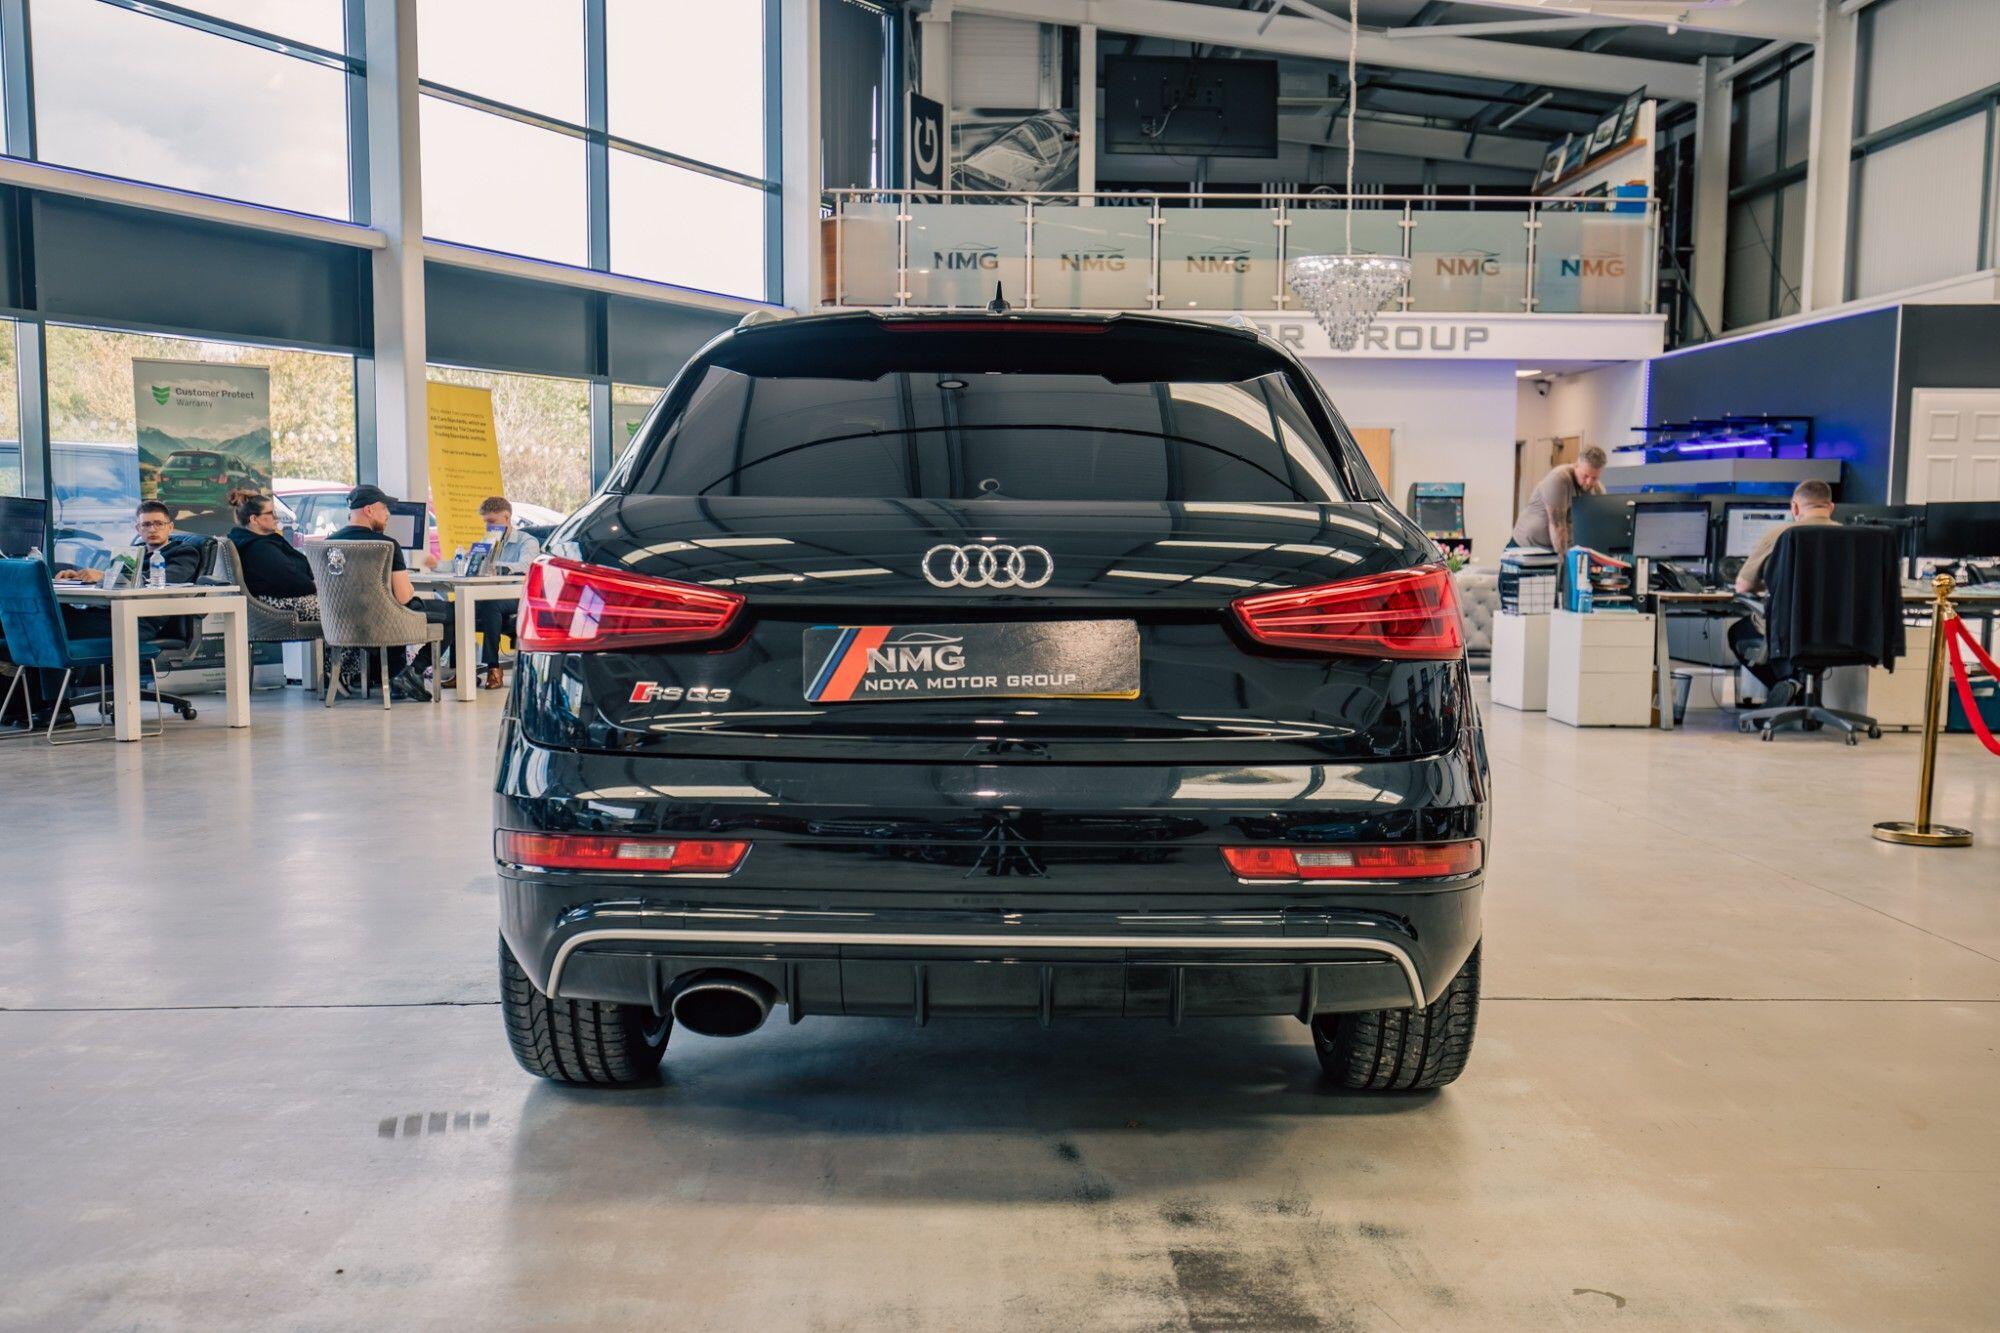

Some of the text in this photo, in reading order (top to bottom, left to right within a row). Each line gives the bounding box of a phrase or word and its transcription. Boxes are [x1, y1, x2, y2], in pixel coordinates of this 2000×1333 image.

[933, 251, 999, 270] NMG
[1060, 253, 1125, 272] NMG
[1186, 255, 1250, 273] NMG
[1436, 258, 1500, 276] NMG
[1561, 259, 1625, 276] NMG
[175, 387, 254, 399] Customer Protect
[176, 399, 213, 408] Warranty
[866, 646, 965, 673] NMG
[865, 673, 1077, 691] NOYA MOTOR GROUP
[686, 686, 731, 702] Q3
